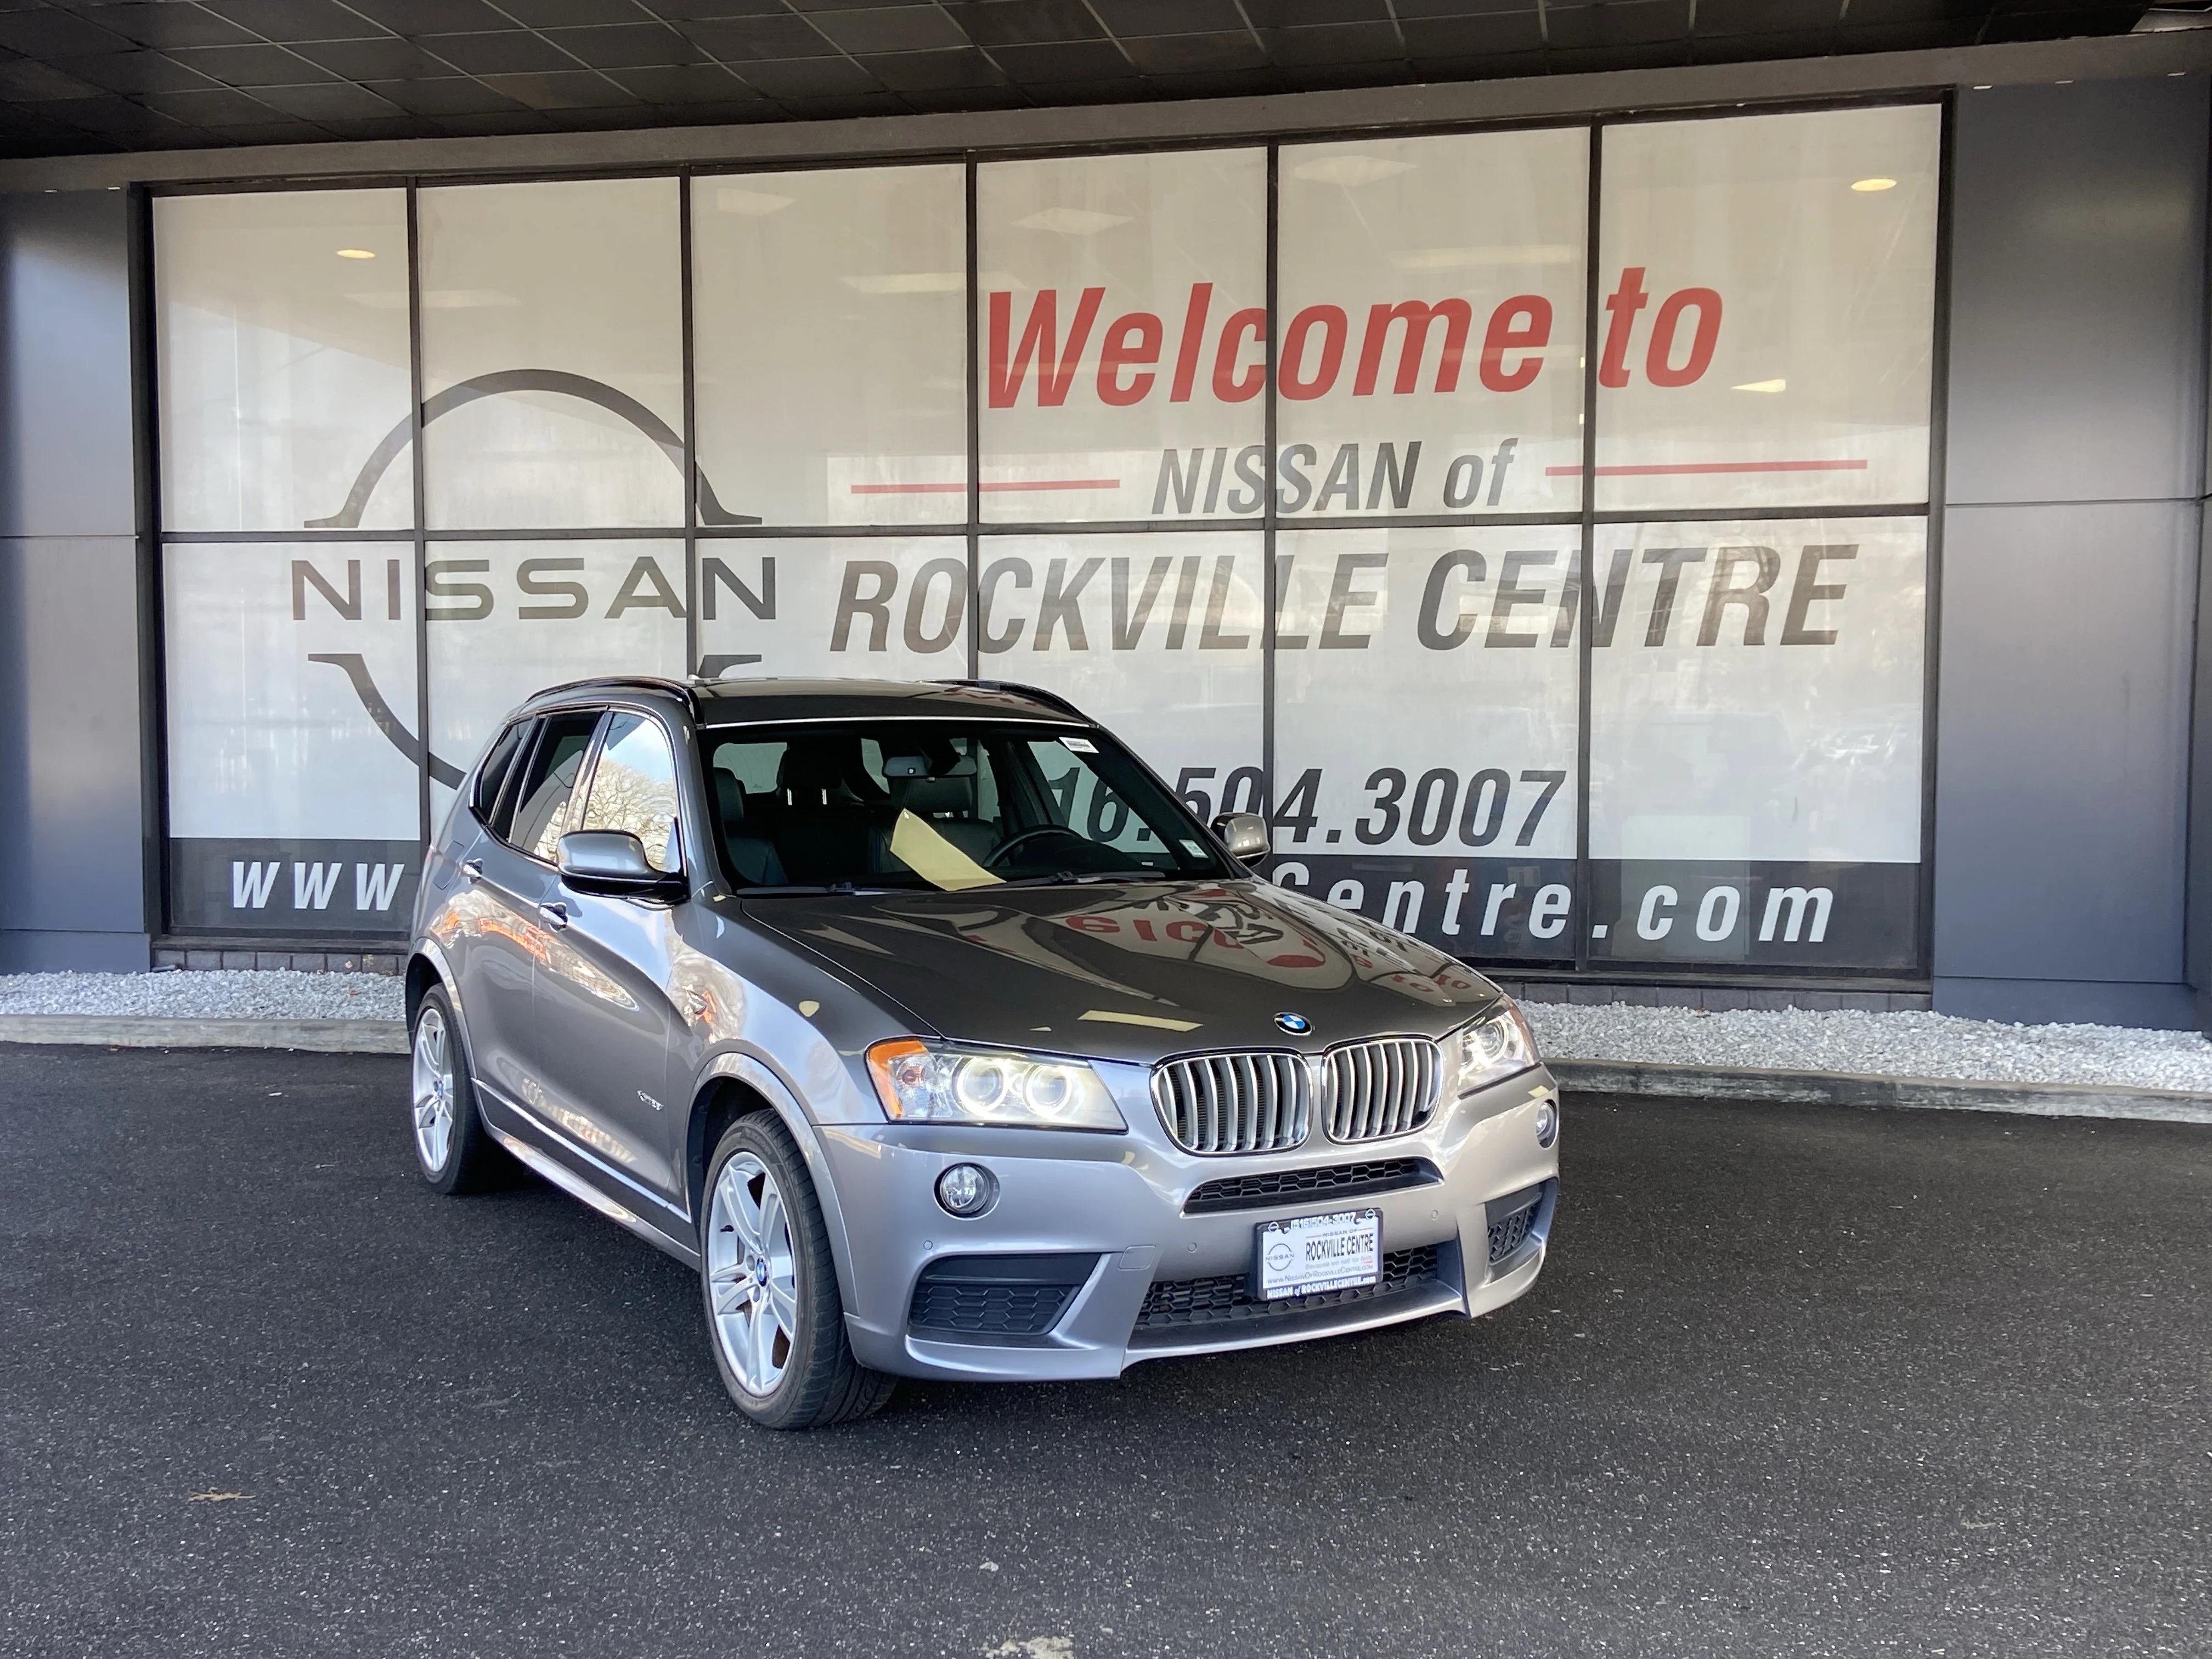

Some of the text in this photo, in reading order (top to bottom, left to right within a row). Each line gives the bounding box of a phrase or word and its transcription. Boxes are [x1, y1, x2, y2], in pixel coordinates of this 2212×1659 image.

[989, 267, 1723, 408] Welcome to
[1152, 438, 1519, 515] NISSAN of
[291, 556, 776, 620] NISSAN
[830, 544, 1859, 653] ROCKVILLE CENTRE
[1048, 766, 1566, 847] 16.504.3007
[1265, 1252, 1295, 1261] NISSAN
[1306, 1233, 1373, 1261] ROCKVILLE CENTRE
[1267, 1286, 1293, 1299] NISSAN
